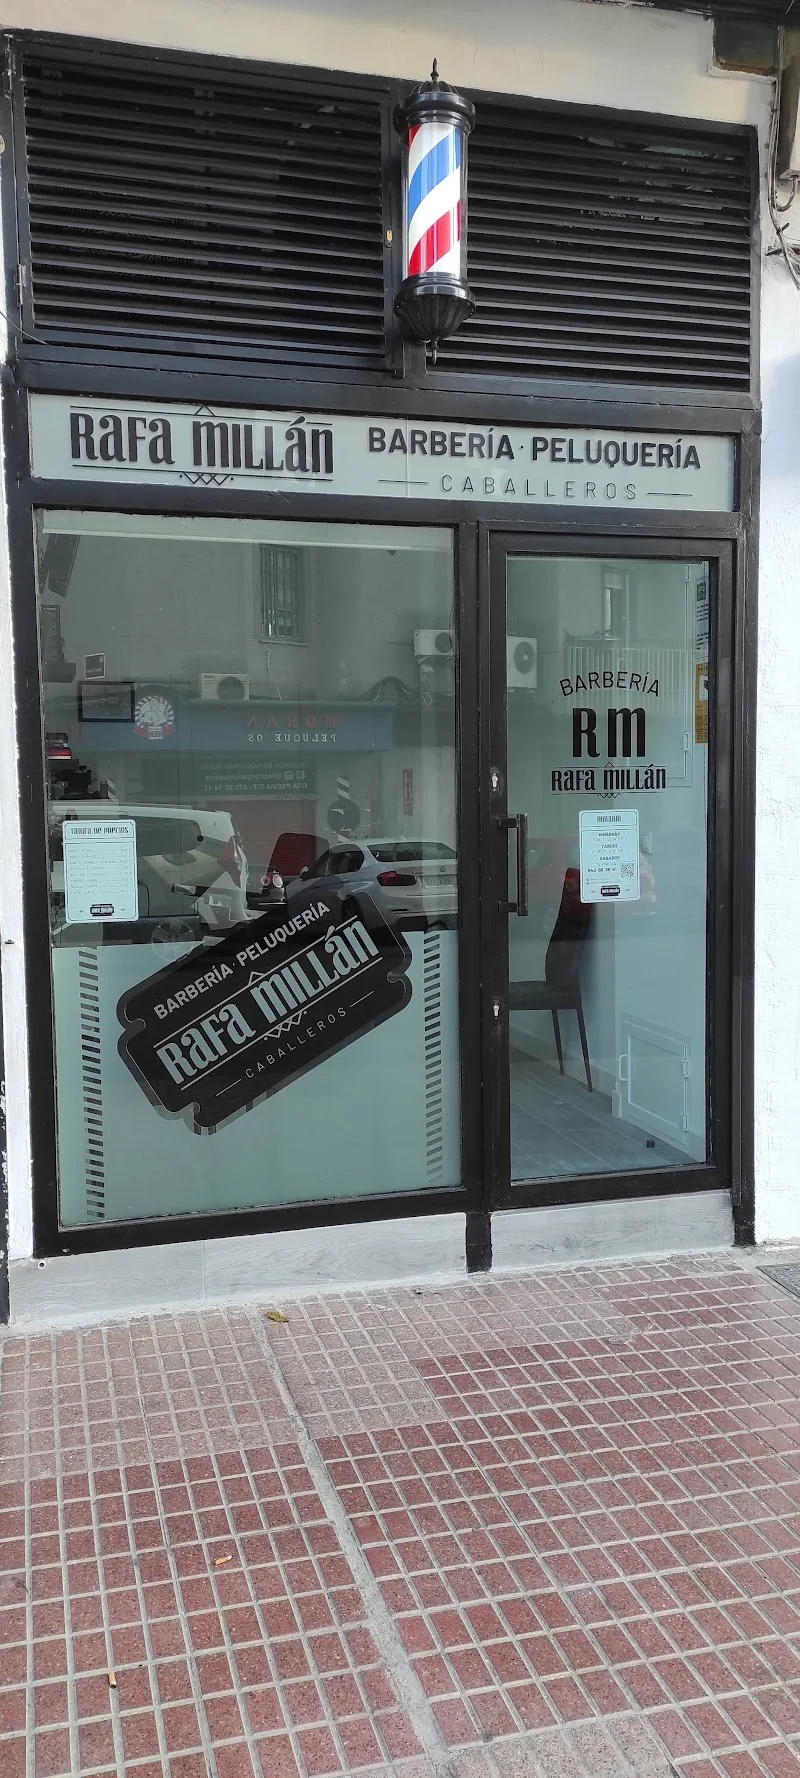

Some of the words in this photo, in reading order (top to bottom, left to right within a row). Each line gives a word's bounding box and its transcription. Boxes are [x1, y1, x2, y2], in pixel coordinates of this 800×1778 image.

[368, 426, 515, 460] BARBERÍA
[532, 436, 701, 469] PELUQUERÍA
[441, 474, 637, 500] CABALLEROS
[559, 671, 660, 698] BARBERÍA
[153, 961, 234, 1020] BARBERÍA
[236, 901, 331, 967] PELUQUERÍA
[245, 1007, 348, 1079] CABALLEROS
